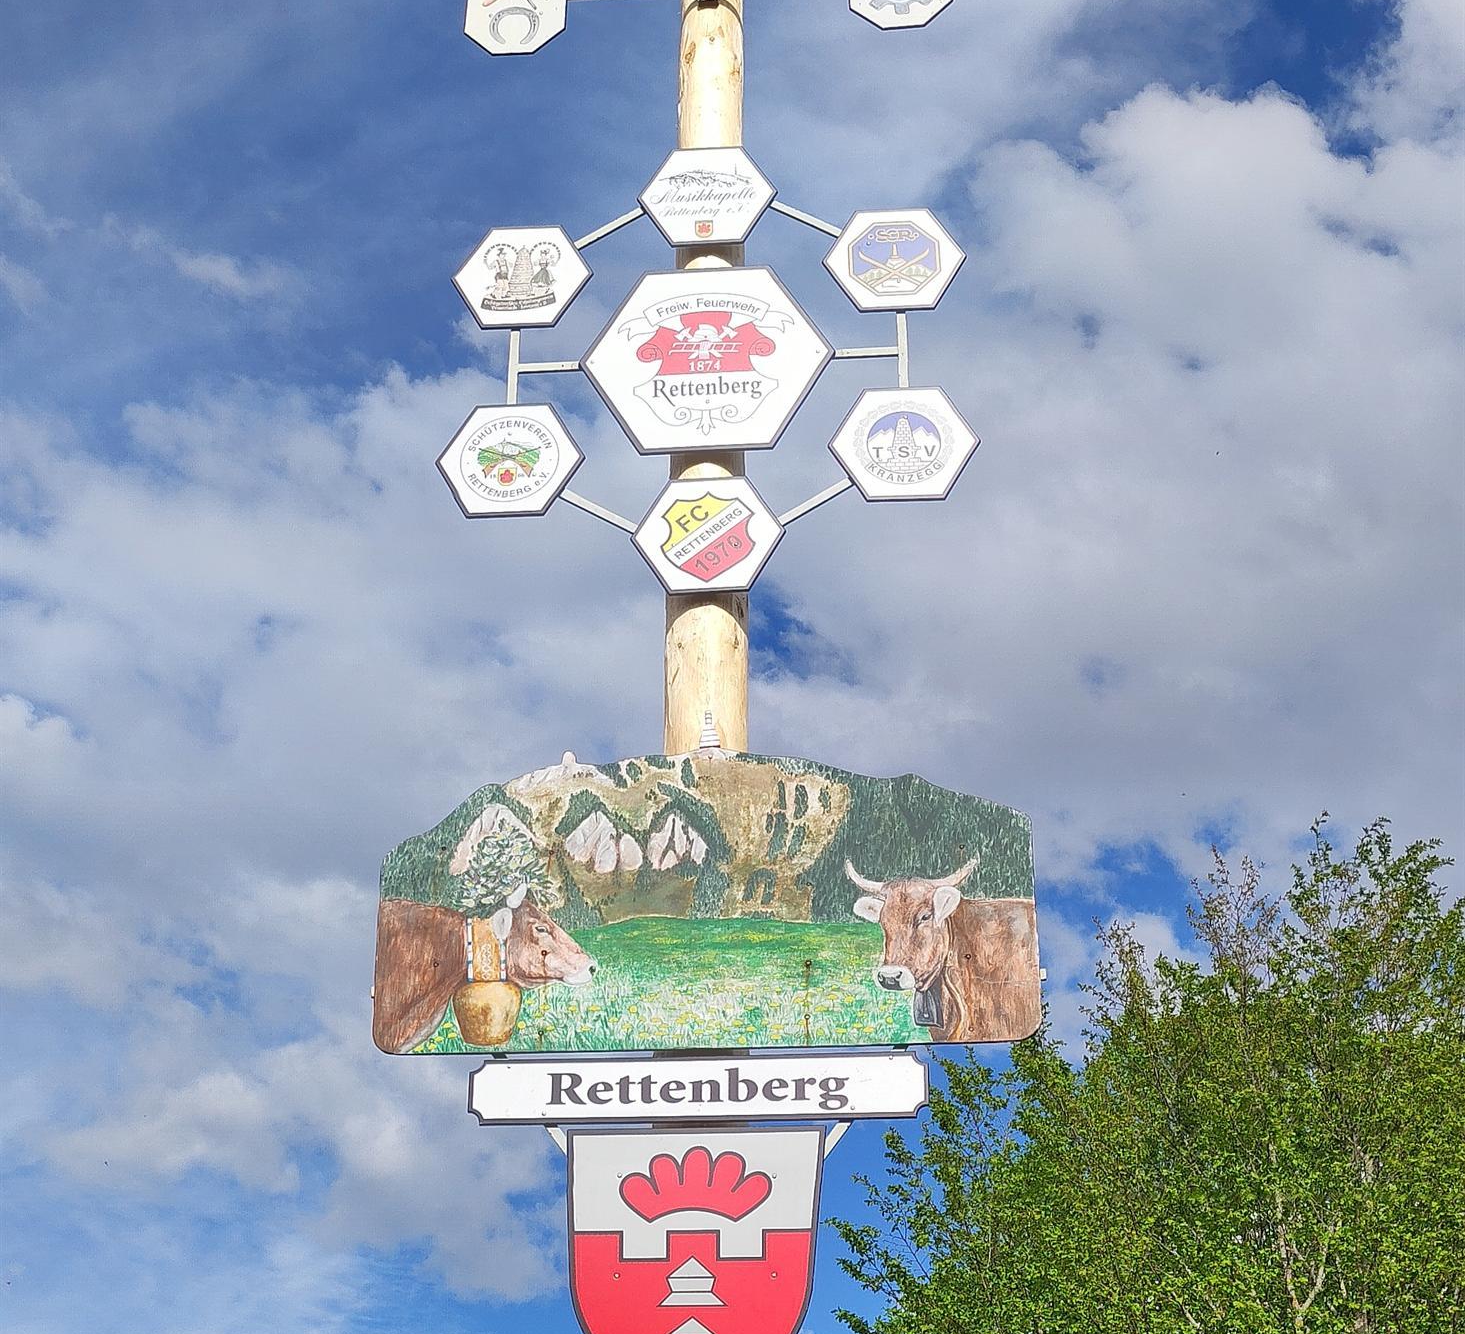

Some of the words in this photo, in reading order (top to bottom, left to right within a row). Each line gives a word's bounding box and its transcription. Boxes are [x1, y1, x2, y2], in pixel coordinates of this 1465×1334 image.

[650, 187, 757, 205] Musikkapelle
[656, 301, 693, 317] Freiw.
[696, 298, 761, 314] Feuerwehr
[688, 359, 721, 372] 1874
[652, 376, 762, 407] Rettenberg
[468, 420, 553, 452] SCHÜTZENVEREIN
[468, 473, 532, 499] RETTENBERG
[534, 471, 550, 486] e.V.
[867, 461, 942, 482] KRANZEGG
[675, 505, 710, 533] FC
[674, 508, 743, 560] RETTENBERG
[695, 534, 743, 572] 1970
[546, 1067, 850, 1110] Rettenberg
